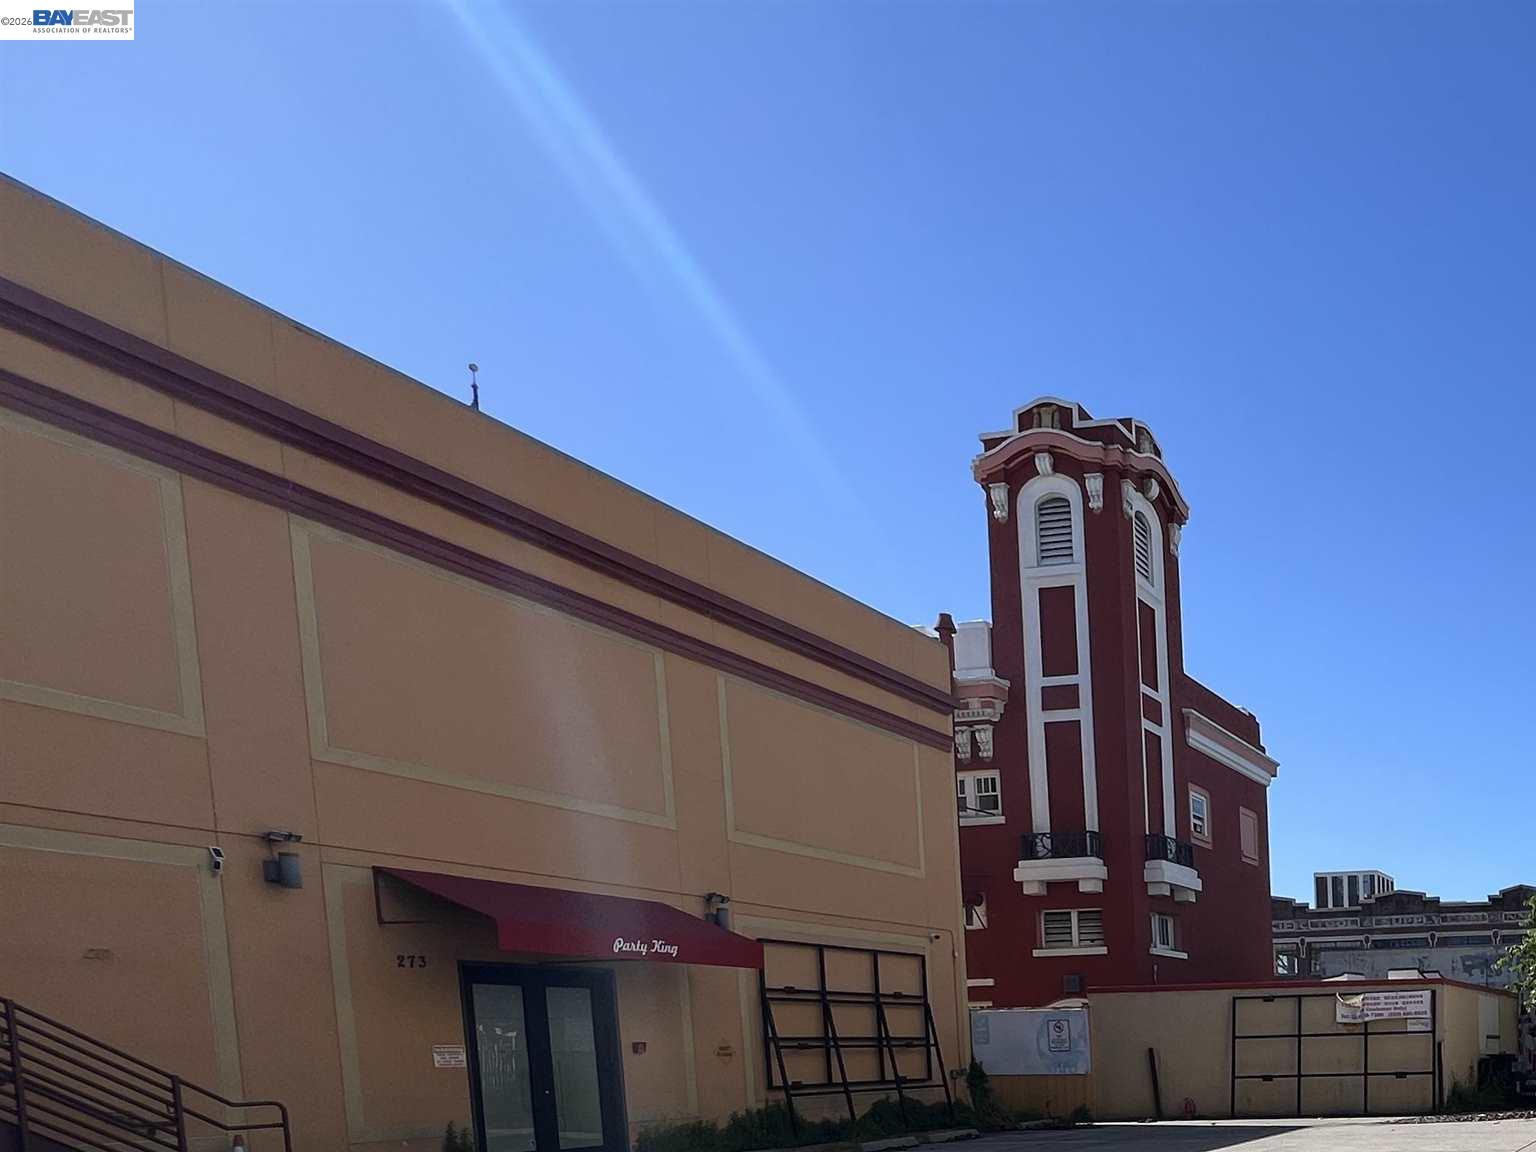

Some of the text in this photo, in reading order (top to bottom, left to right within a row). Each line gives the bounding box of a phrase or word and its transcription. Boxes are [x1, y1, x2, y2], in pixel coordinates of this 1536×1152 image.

[613, 937, 679, 957] Party King
[396, 955, 426, 968] 273
